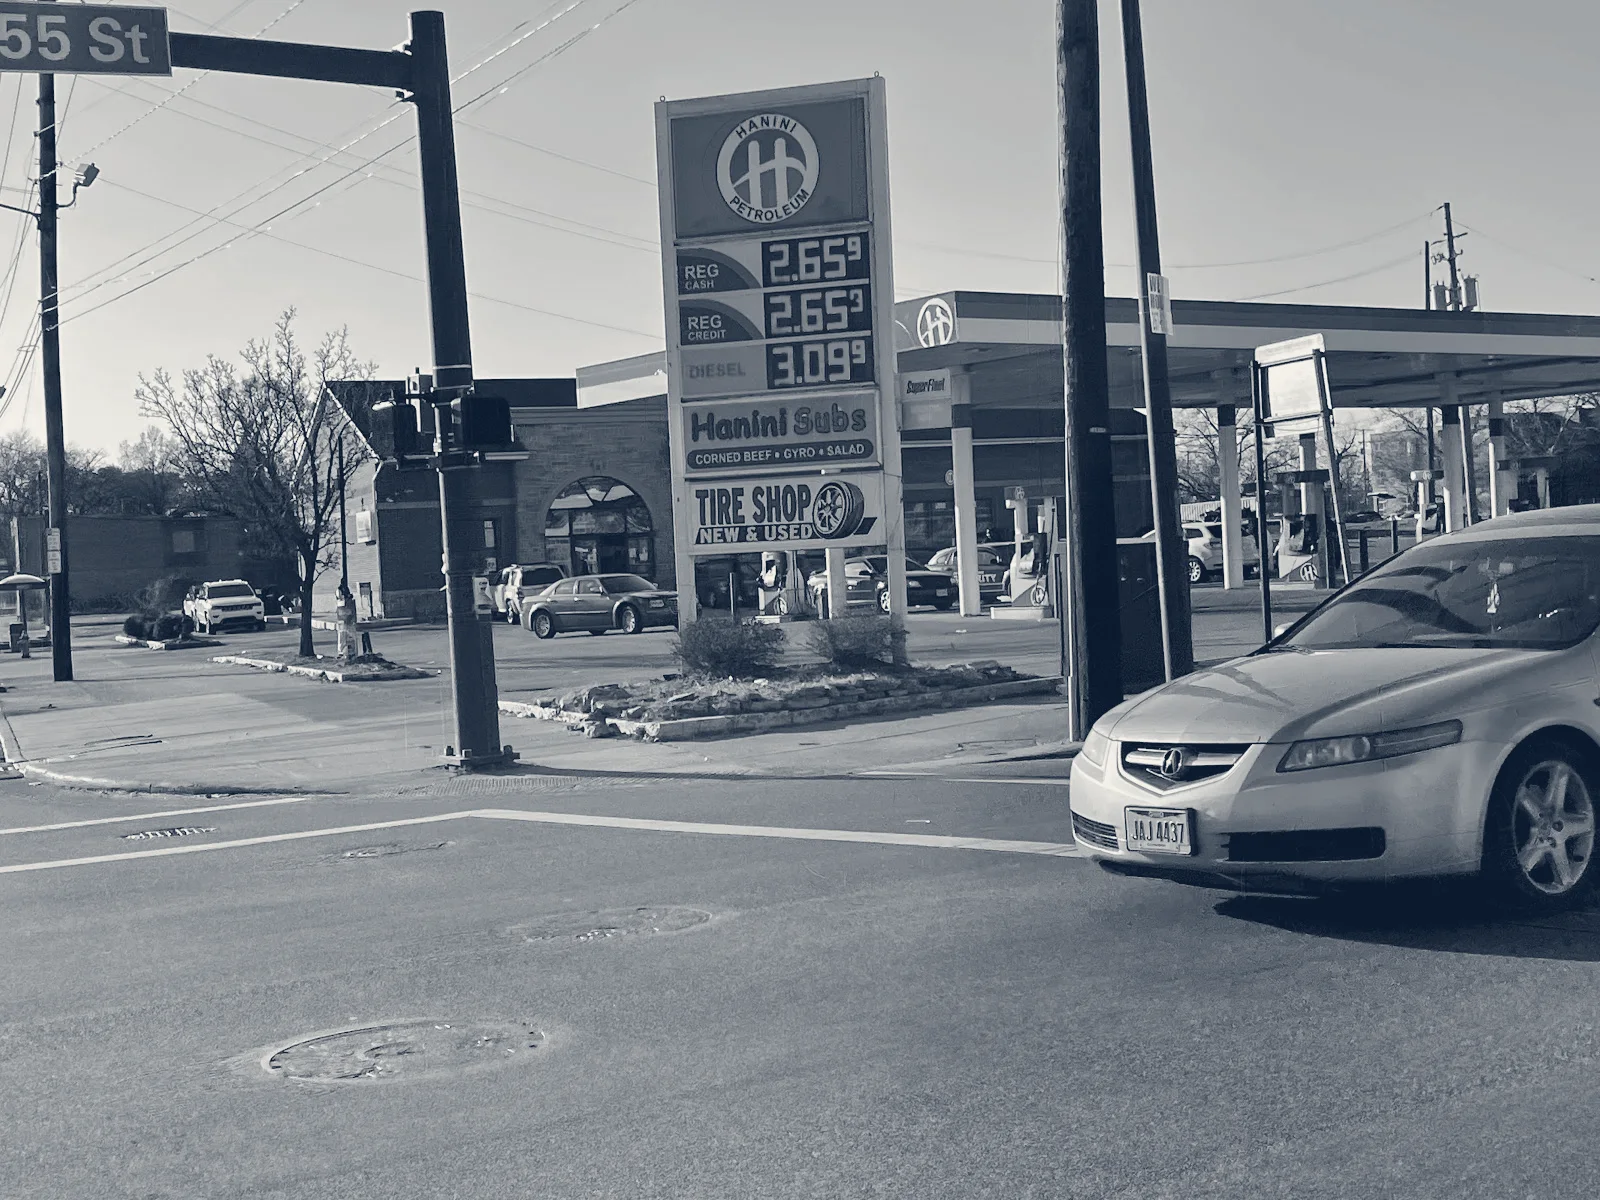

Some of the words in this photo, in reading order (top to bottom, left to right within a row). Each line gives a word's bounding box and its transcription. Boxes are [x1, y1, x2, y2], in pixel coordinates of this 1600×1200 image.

[0, 13, 71, 61] 55
[89, 17, 150, 64] St
[735, 115, 797, 139] HANINI
[730, 188, 810, 221] PETROLEUM
[684, 263, 720, 280] REG
[684, 280, 715, 291] CASH
[687, 314, 722, 330] REG
[687, 329, 727, 341] CREDIT
[688, 362, 746, 380] DIESEL
[691, 408, 788, 442] Hanini
[793, 403, 867, 435] Subs
[696, 452, 741, 465] CORNED
[744, 450, 772, 462] BEEF
[784, 447, 816, 459] GYRO
[827, 444, 865, 456] SALAD
[695, 487, 745, 526] TIRE
[752, 484, 812, 524] SHOP
[701, 526, 740, 543] NEW
[746, 526, 759, 542] &
[764, 523, 812, 541] USED
[1132, 820, 1153, 841] JAJ
[1157, 821, 1184, 844] 4437
